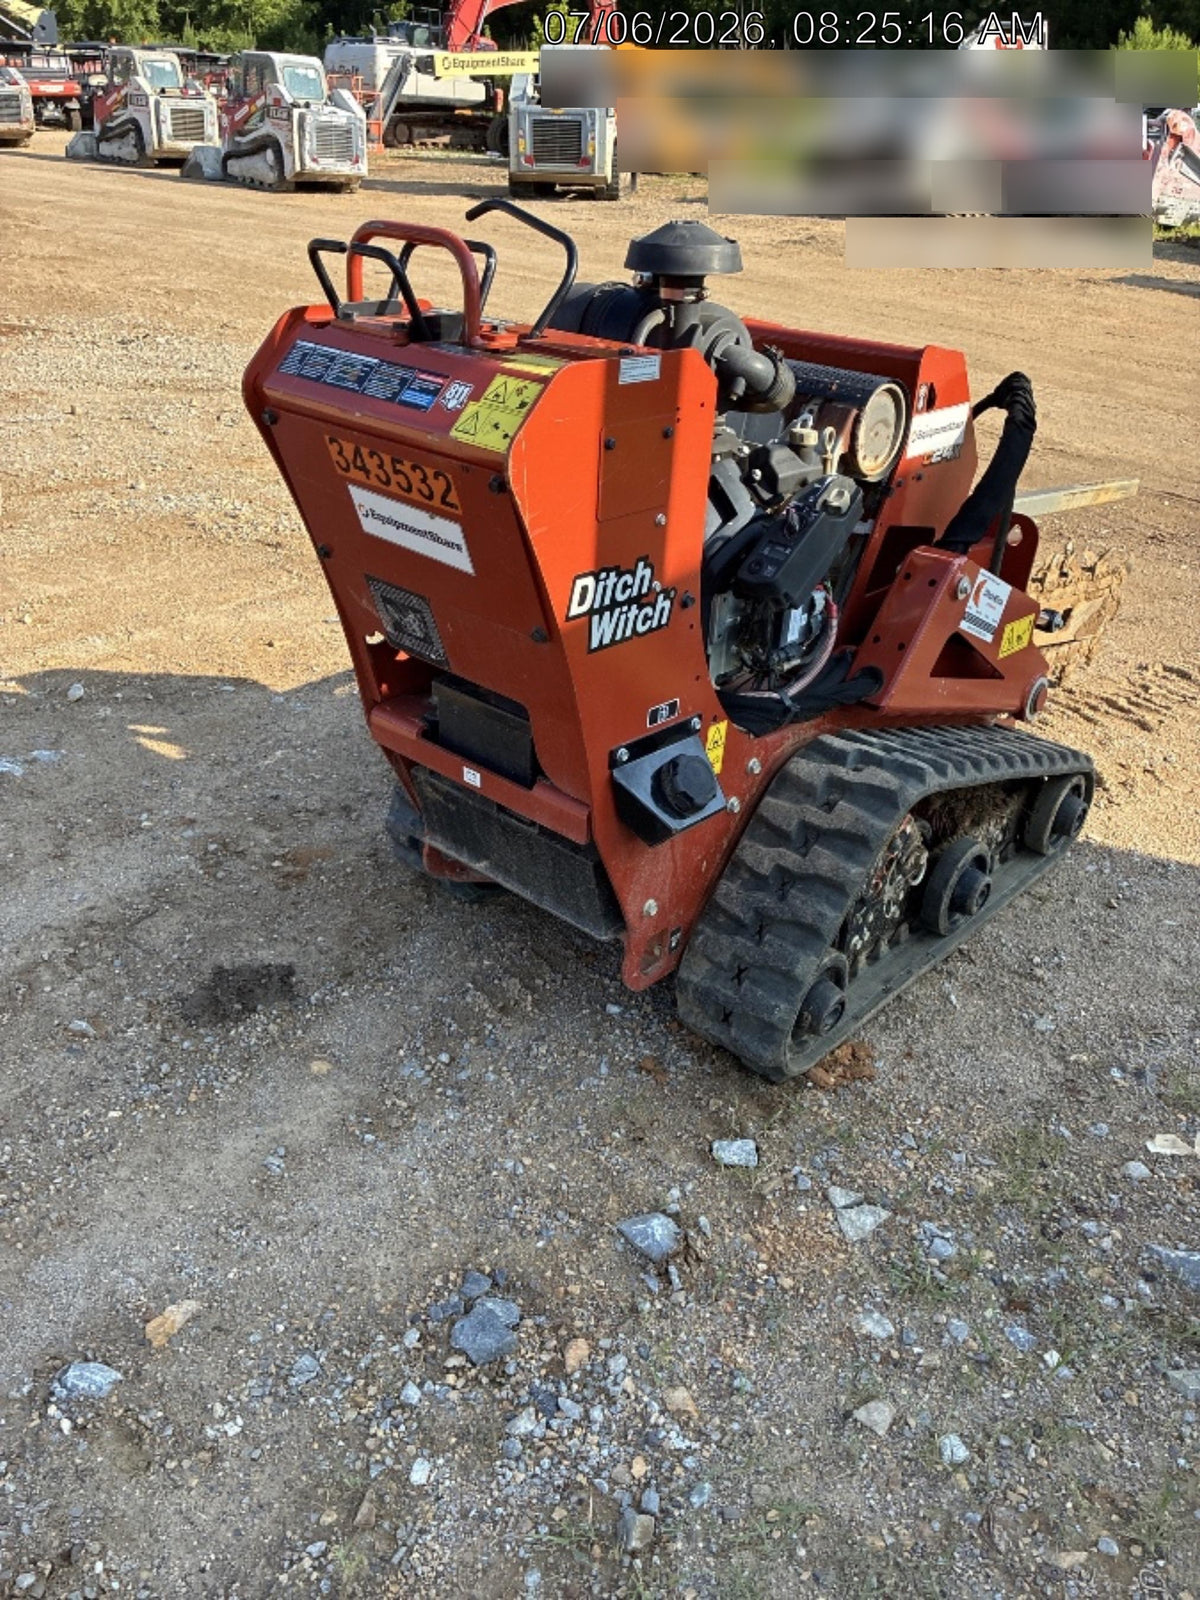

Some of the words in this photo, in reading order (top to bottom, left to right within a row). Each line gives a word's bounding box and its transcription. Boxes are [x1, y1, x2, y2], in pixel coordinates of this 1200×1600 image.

[452, 56, 526, 70] EquipmentShare
[328, 436, 459, 510] 343532
[369, 508, 463, 553] EquipmentShare
[567, 560, 652, 618] Ditch
[590, 593, 671, 650] Witch
